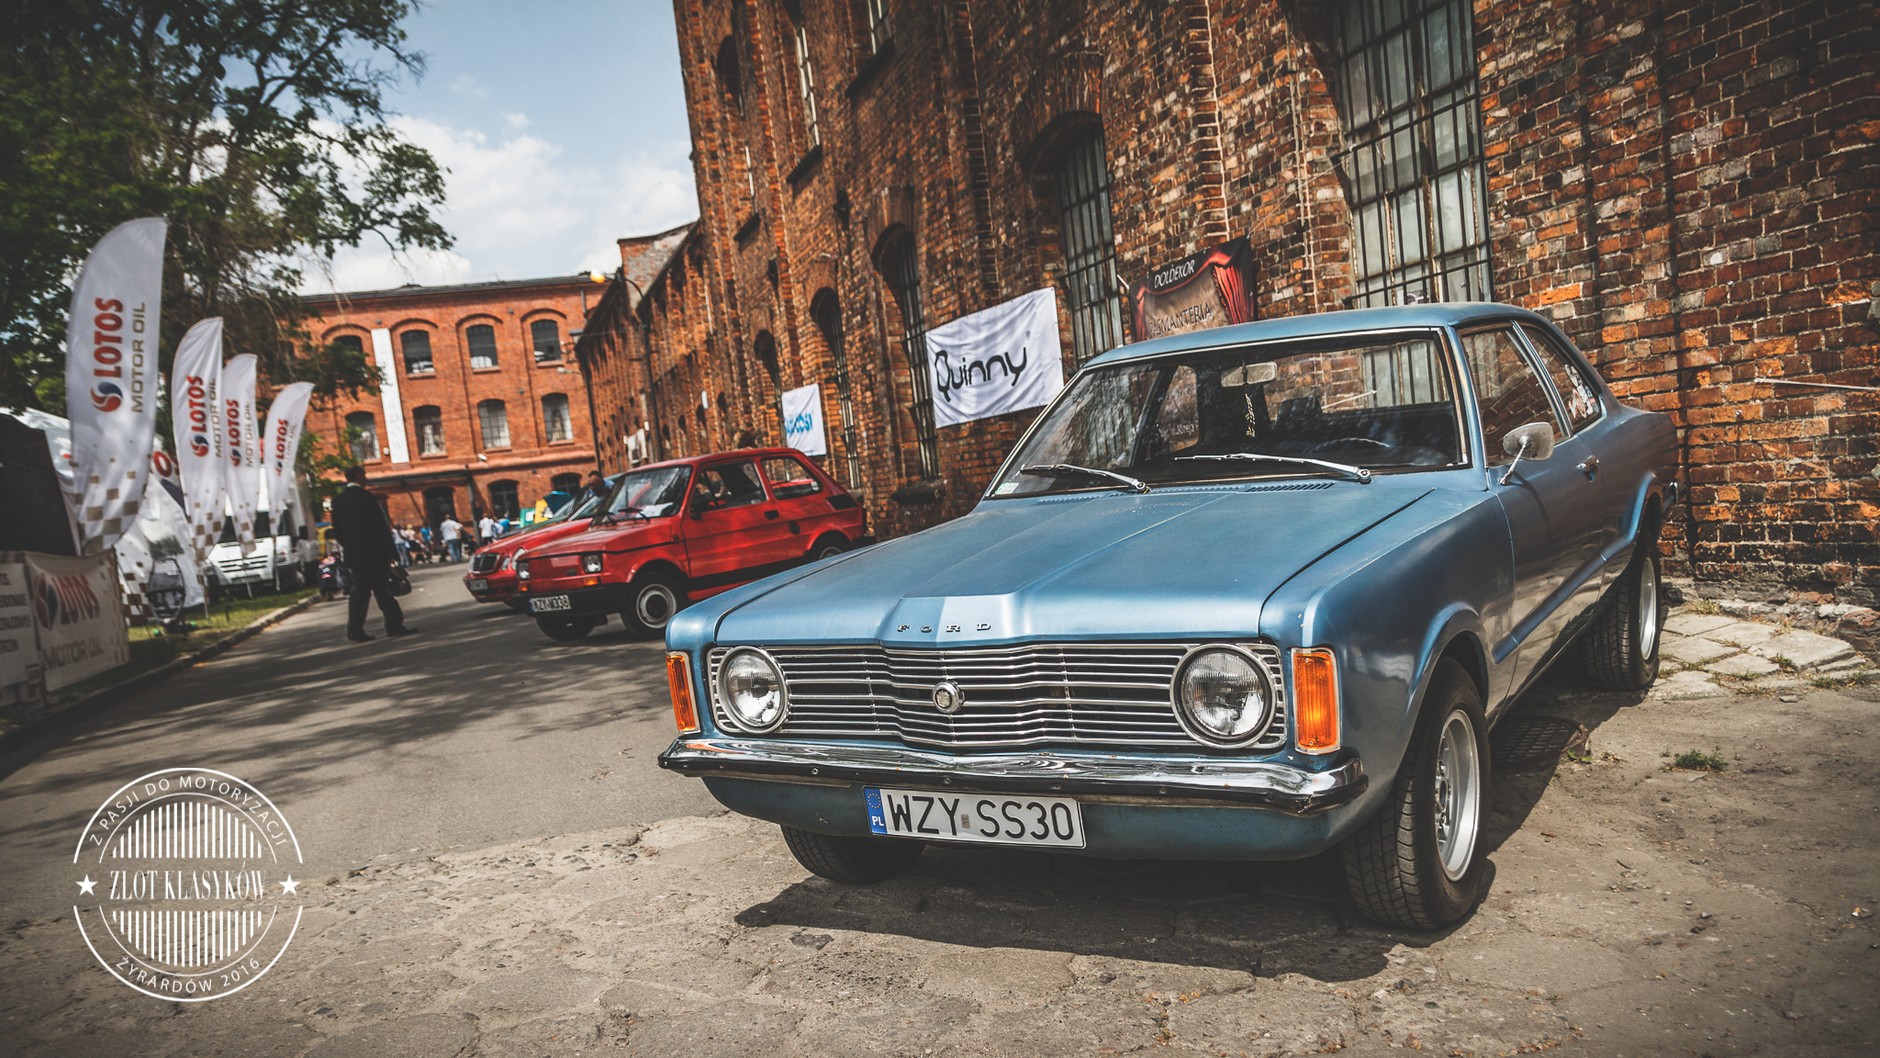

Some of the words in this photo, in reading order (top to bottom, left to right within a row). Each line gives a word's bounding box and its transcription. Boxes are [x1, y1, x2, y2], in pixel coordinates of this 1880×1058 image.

[93, 297, 124, 379] LOTOS
[132, 302, 146, 335] OIL
[131, 339, 145, 413] MOTOR
[208, 378, 217, 401] OIL
[934, 346, 1028, 403] Quinny
[186, 375, 207, 433] LOTOS
[226, 399, 241, 447] LOTOS
[209, 404, 222, 458] MOTOR
[244, 422, 255, 468] MOTOR
[276, 418, 289, 460] LOTOS
[897, 622, 992, 633] FORD
[871, 815, 884, 827] PL
[887, 794, 960, 836] WZY
[976, 799, 1074, 841] SS30
